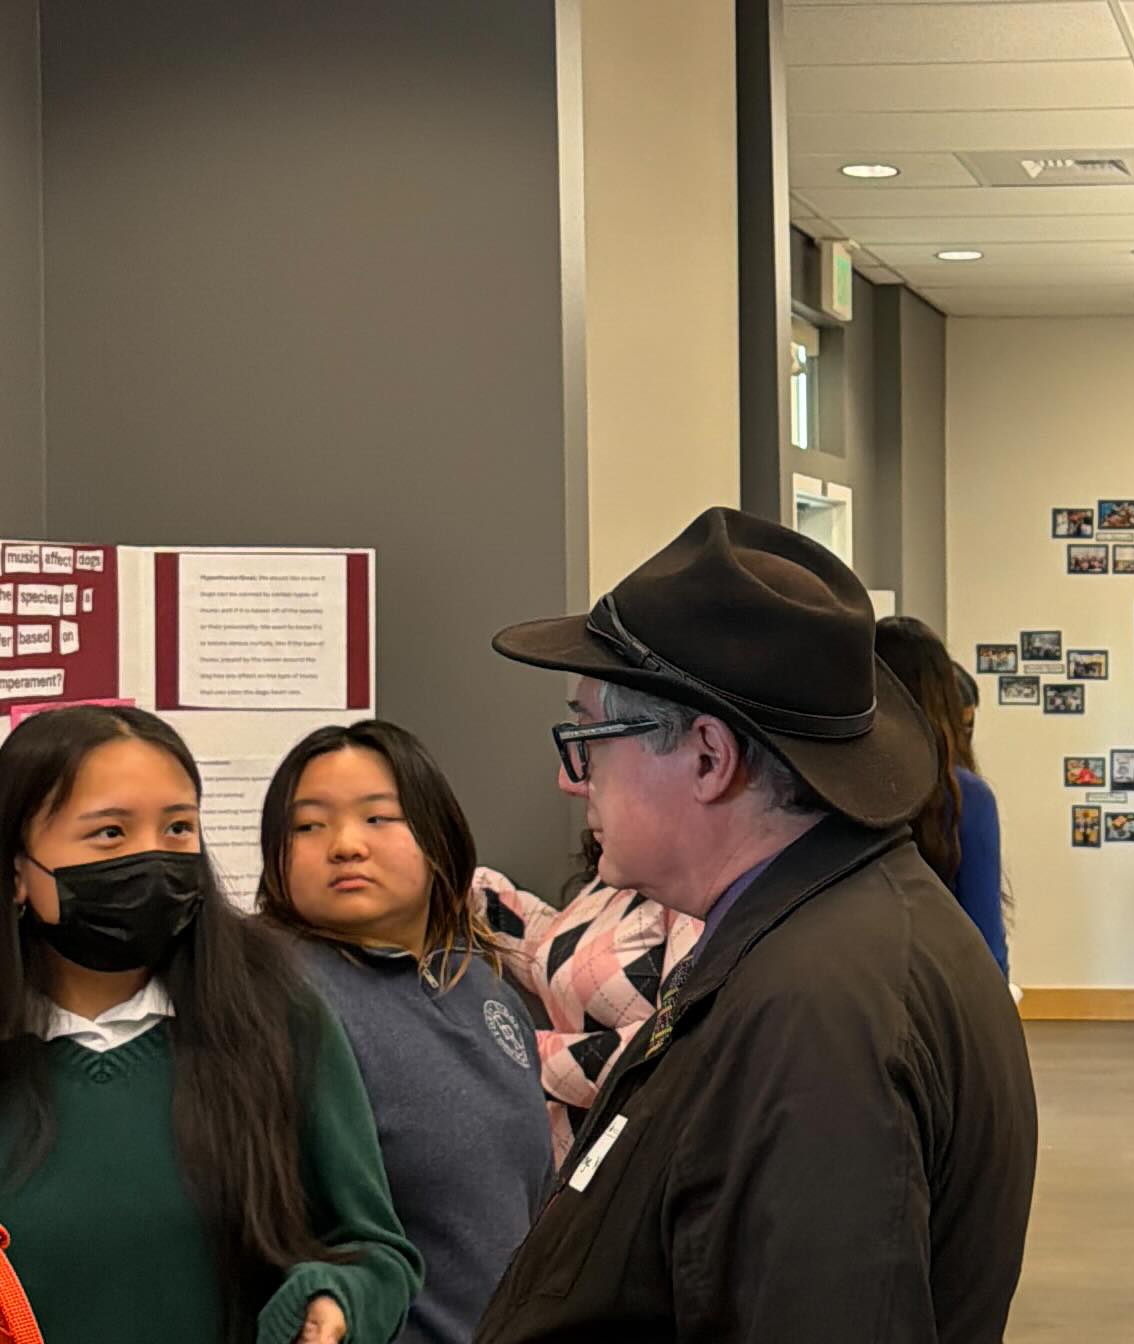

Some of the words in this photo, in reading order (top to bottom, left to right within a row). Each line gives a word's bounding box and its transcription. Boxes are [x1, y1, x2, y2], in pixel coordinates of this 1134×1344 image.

[7, 549, 39, 564] music
[44, 551, 72, 568] affect
[78, 553, 101, 567] dogs
[20, 589, 59, 608] species
[64, 591, 75, 603] as
[19, 629, 50, 645] based
[62, 631, 74, 643] on
